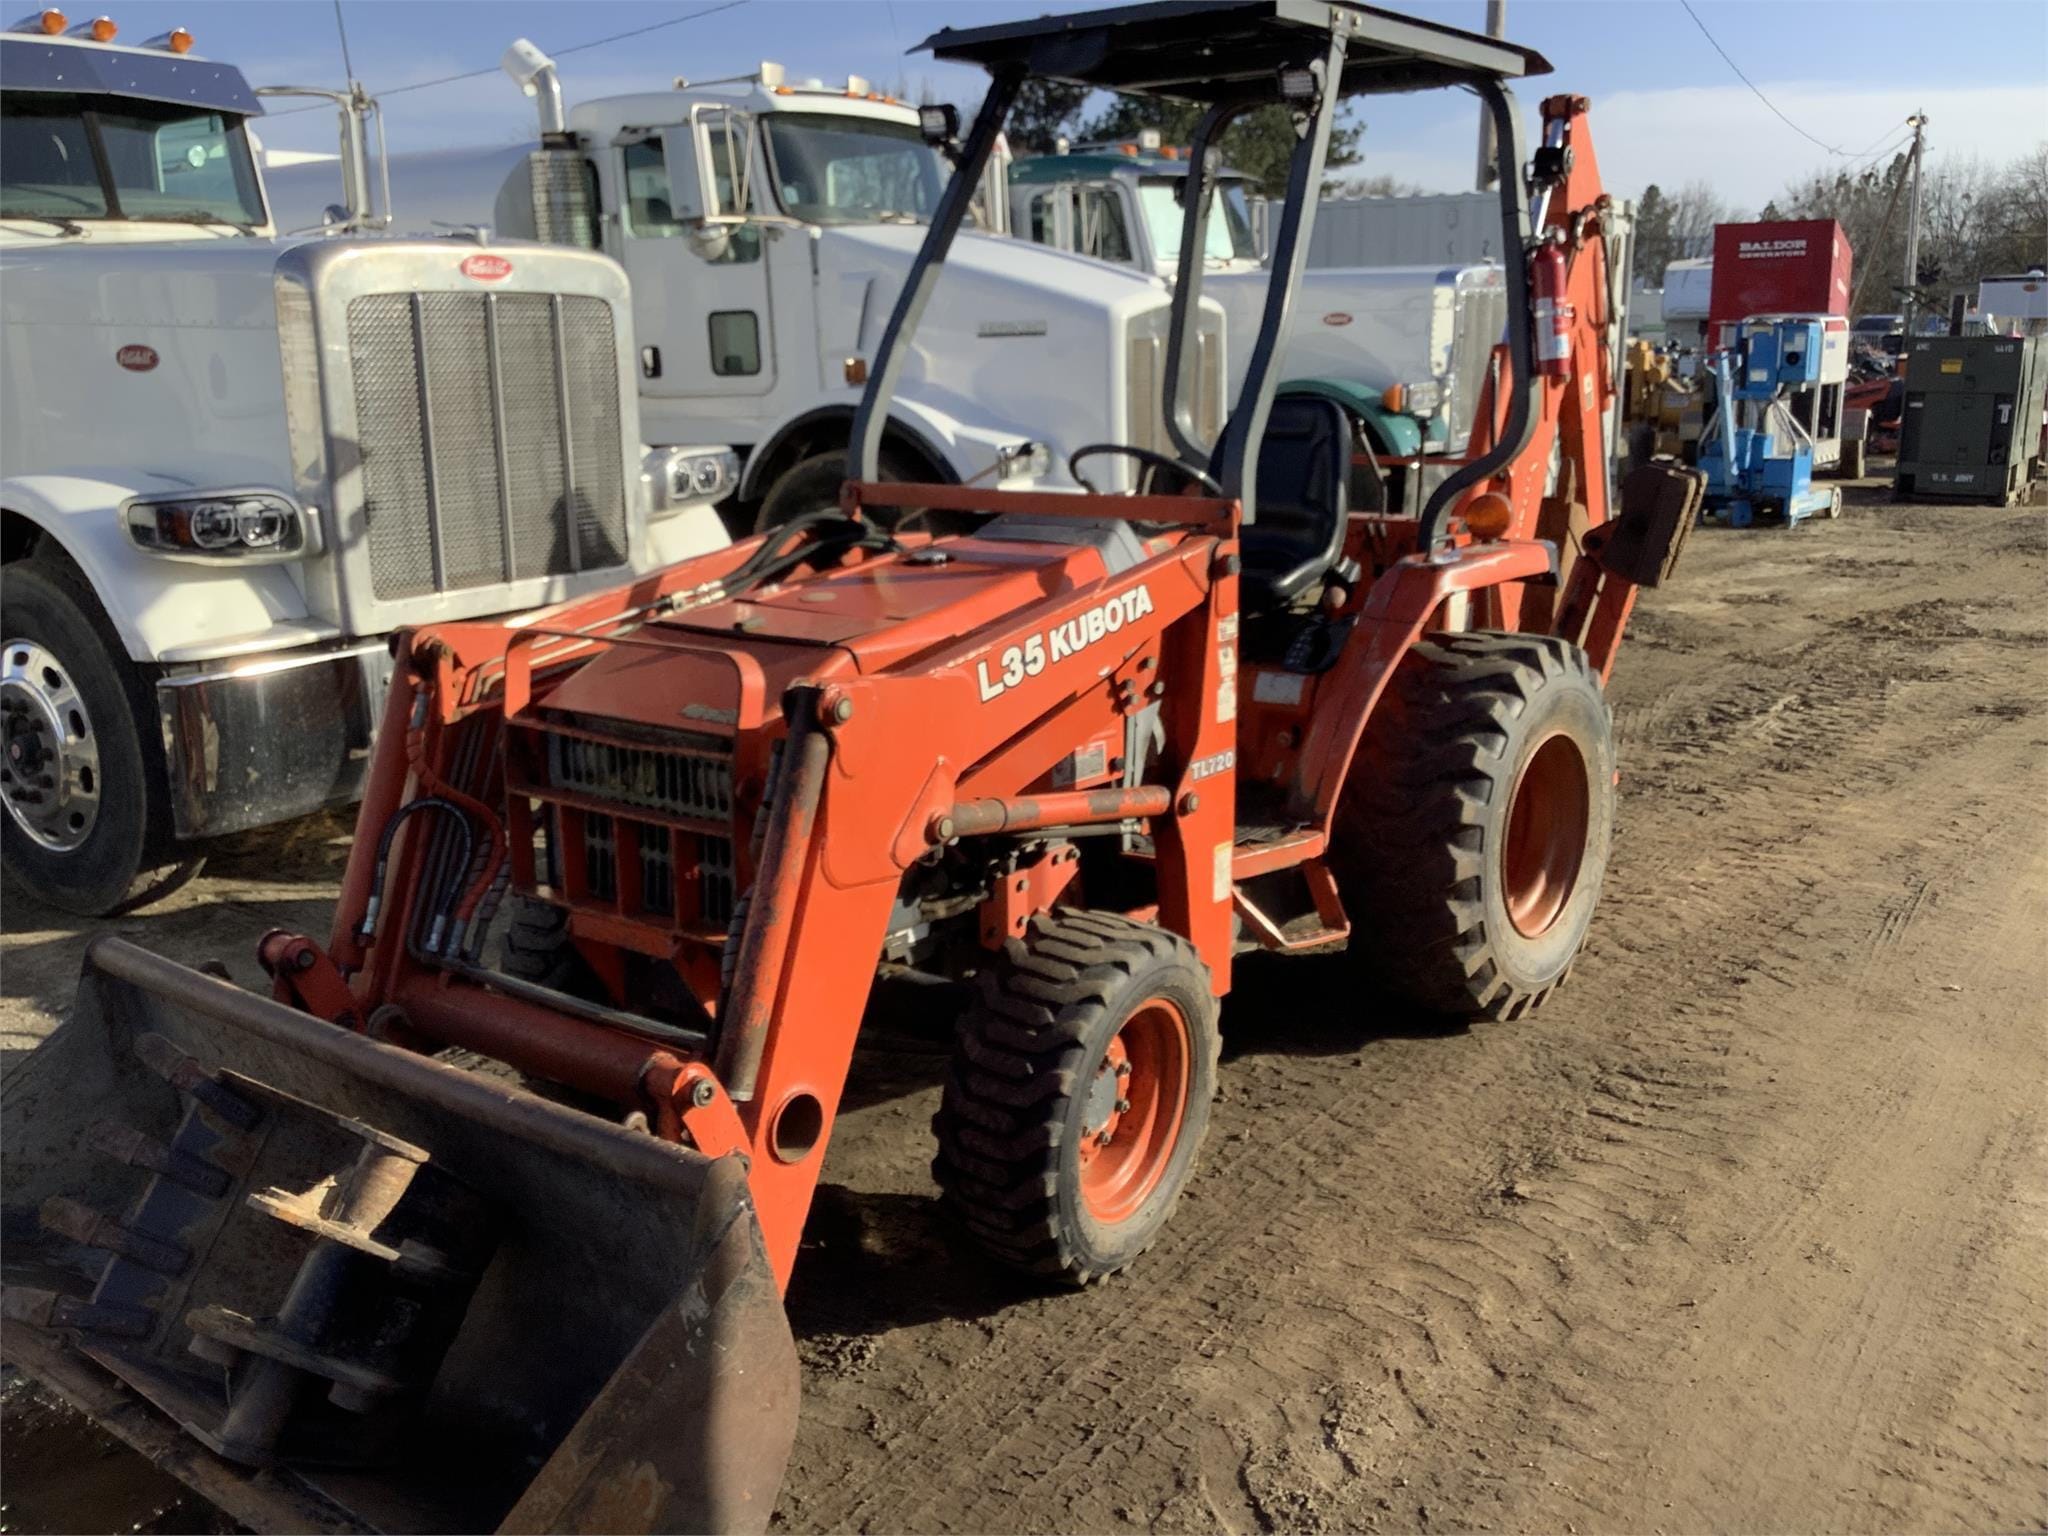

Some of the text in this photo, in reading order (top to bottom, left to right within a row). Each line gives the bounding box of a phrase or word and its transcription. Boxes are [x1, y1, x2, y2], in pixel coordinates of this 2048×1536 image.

[1739, 239, 1807, 252] BALDOR
[977, 584, 1154, 703] L35 KUBOTA
[1190, 750, 1234, 781] TL720
